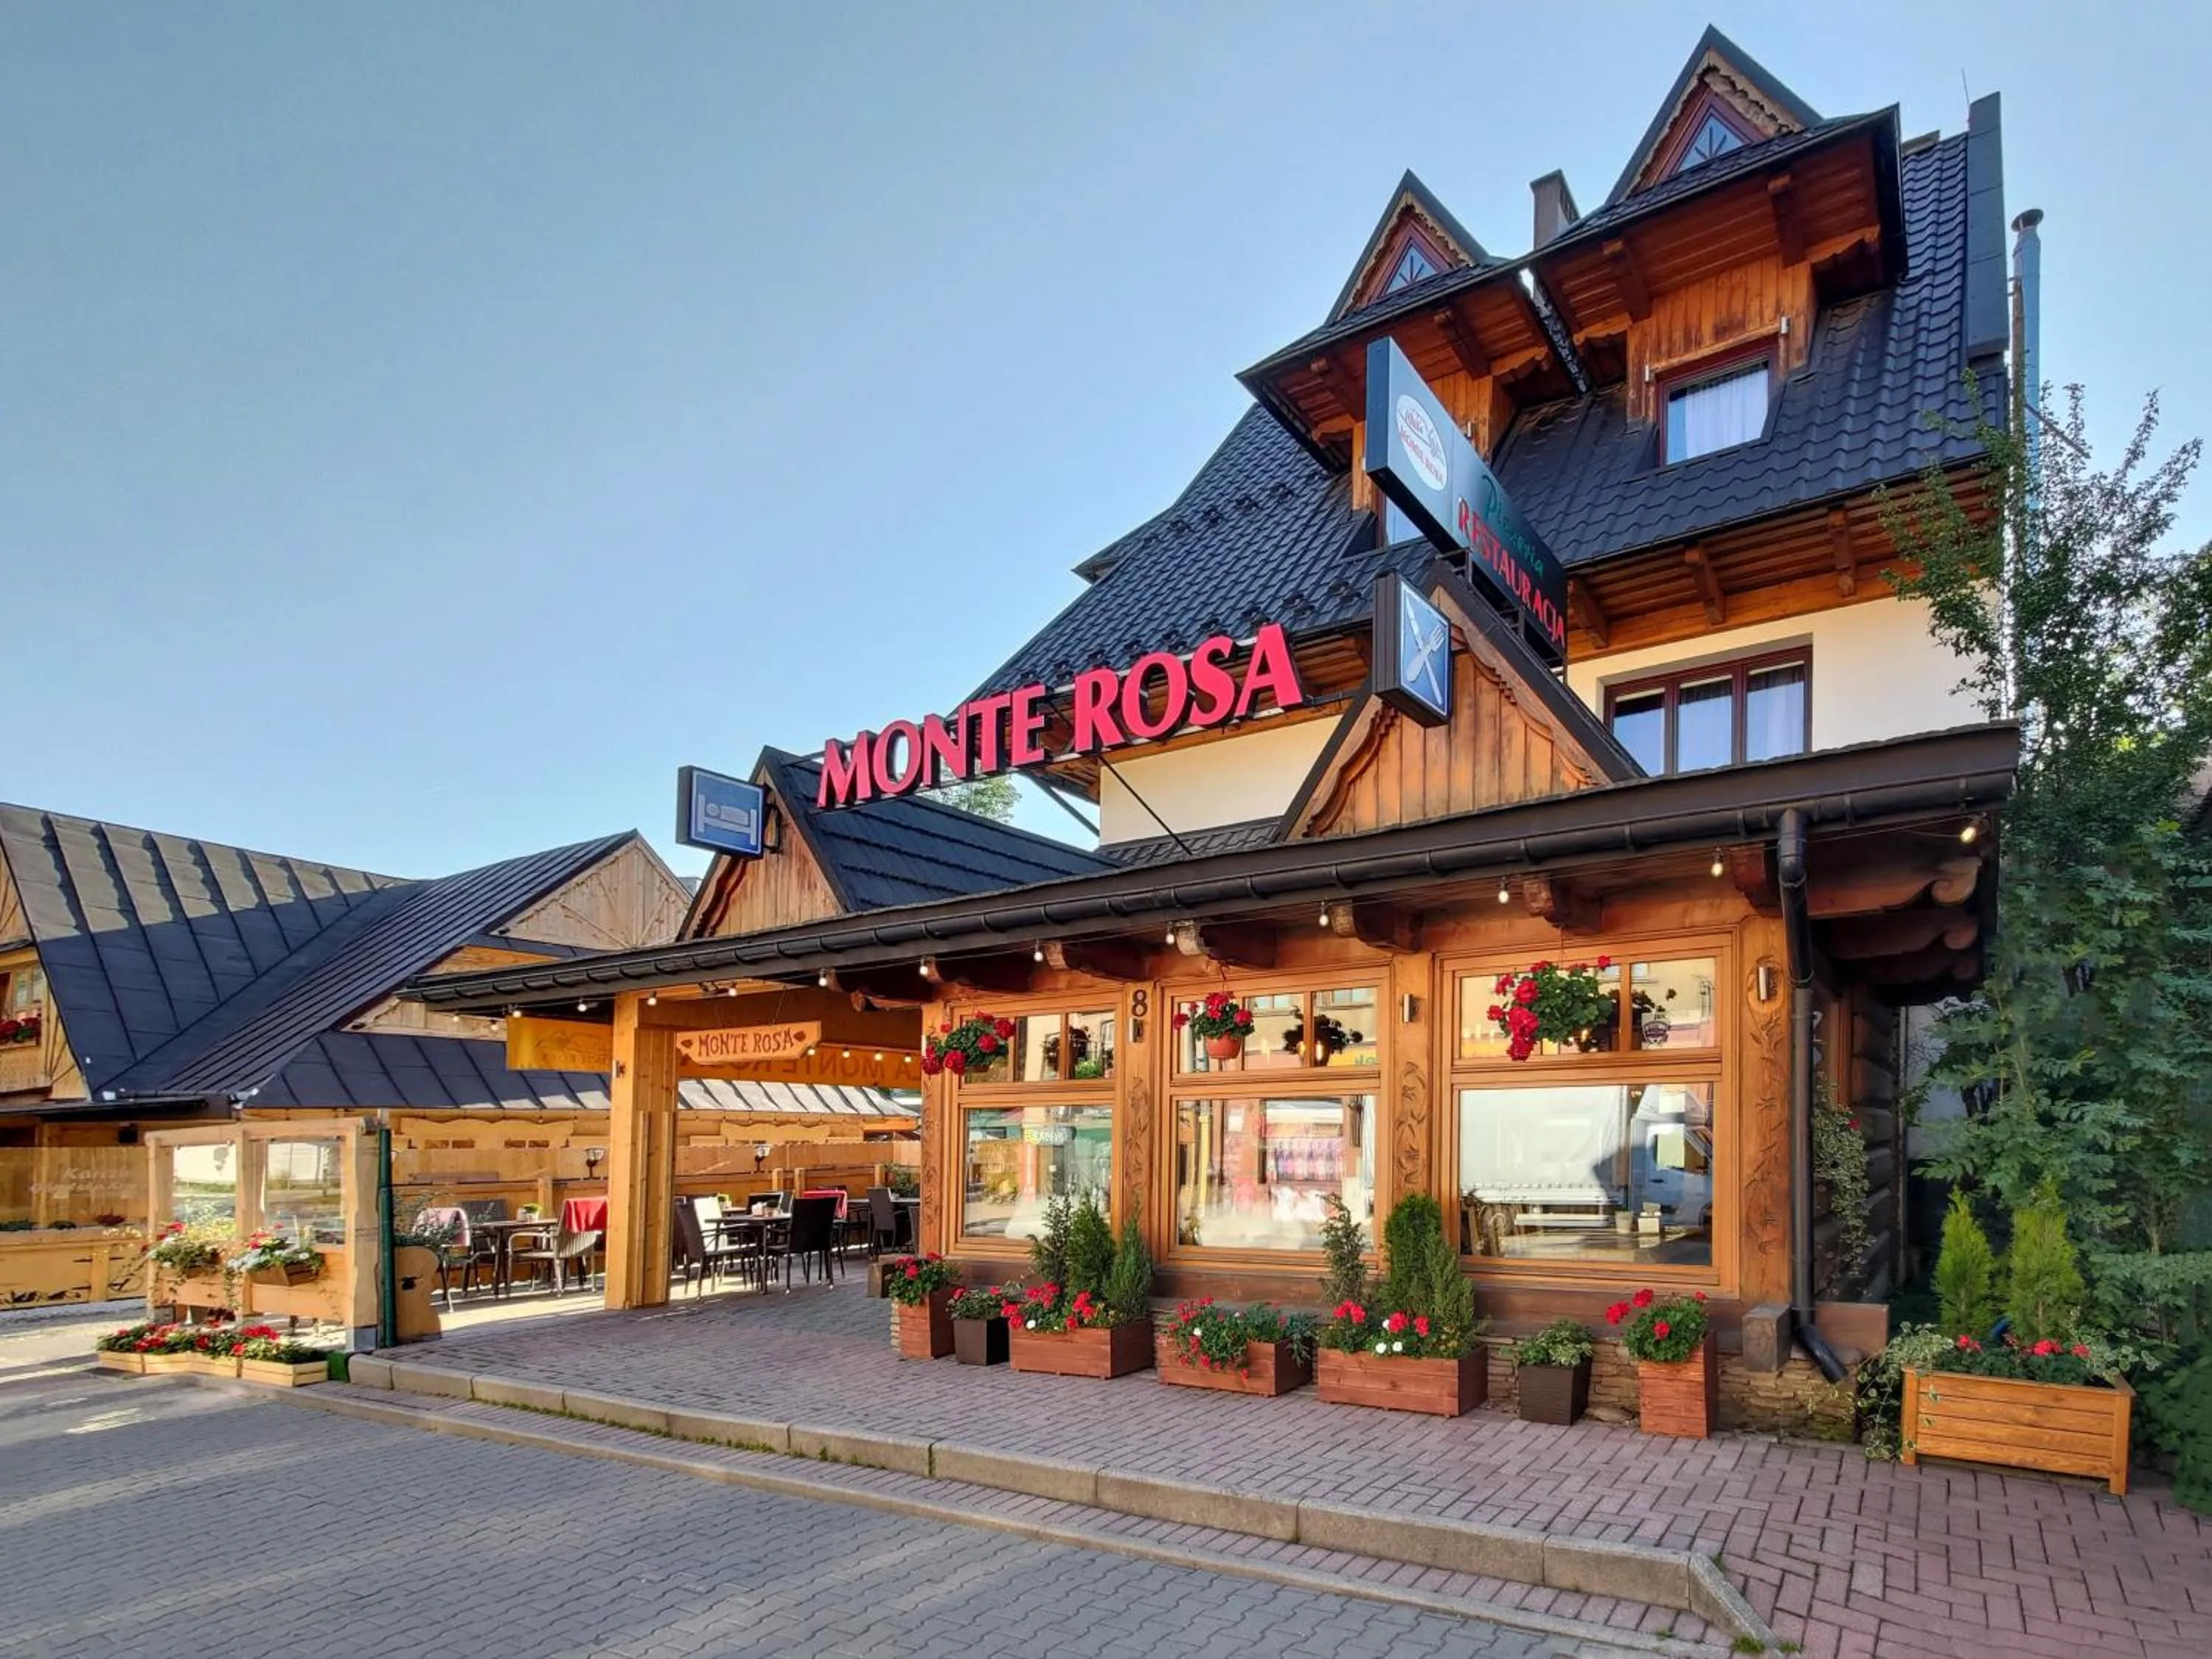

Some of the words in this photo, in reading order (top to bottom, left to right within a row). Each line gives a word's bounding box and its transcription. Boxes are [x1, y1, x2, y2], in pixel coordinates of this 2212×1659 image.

[1458, 495, 1565, 648] RESTAURACJA
[817, 684, 1047, 807] MONTE
[1074, 621, 1303, 754] ROSA
[698, 1033, 748, 1057] MONTE
[754, 1029, 794, 1053] ROSA
[1132, 989, 1147, 1017] 8
